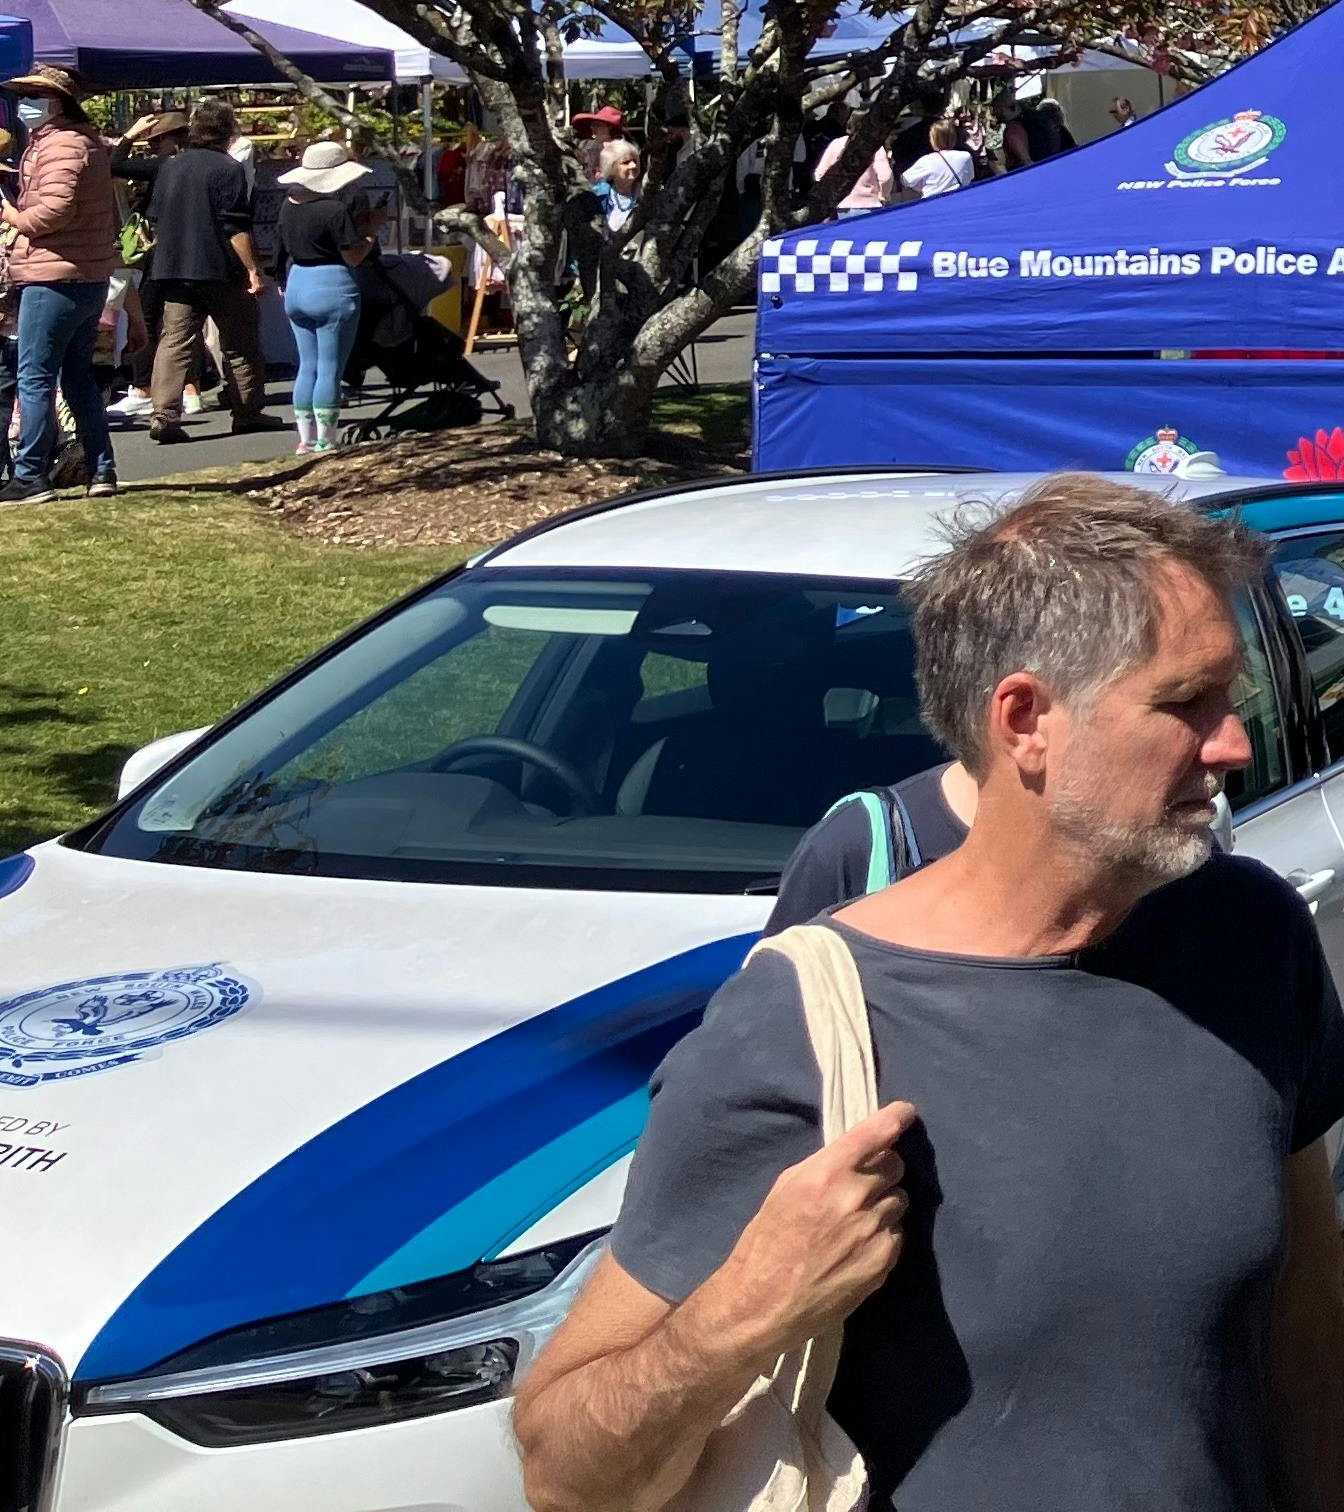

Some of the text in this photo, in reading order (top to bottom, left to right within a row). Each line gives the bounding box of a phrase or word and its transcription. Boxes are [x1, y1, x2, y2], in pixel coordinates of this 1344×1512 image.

[1117, 177, 1282, 190] NSW Police Force
[932, 250, 1010, 278] Blue
[1019, 247, 1201, 278] Mountains
[1210, 246, 1319, 276] Police
[25, 1121, 72, 1137] BY
